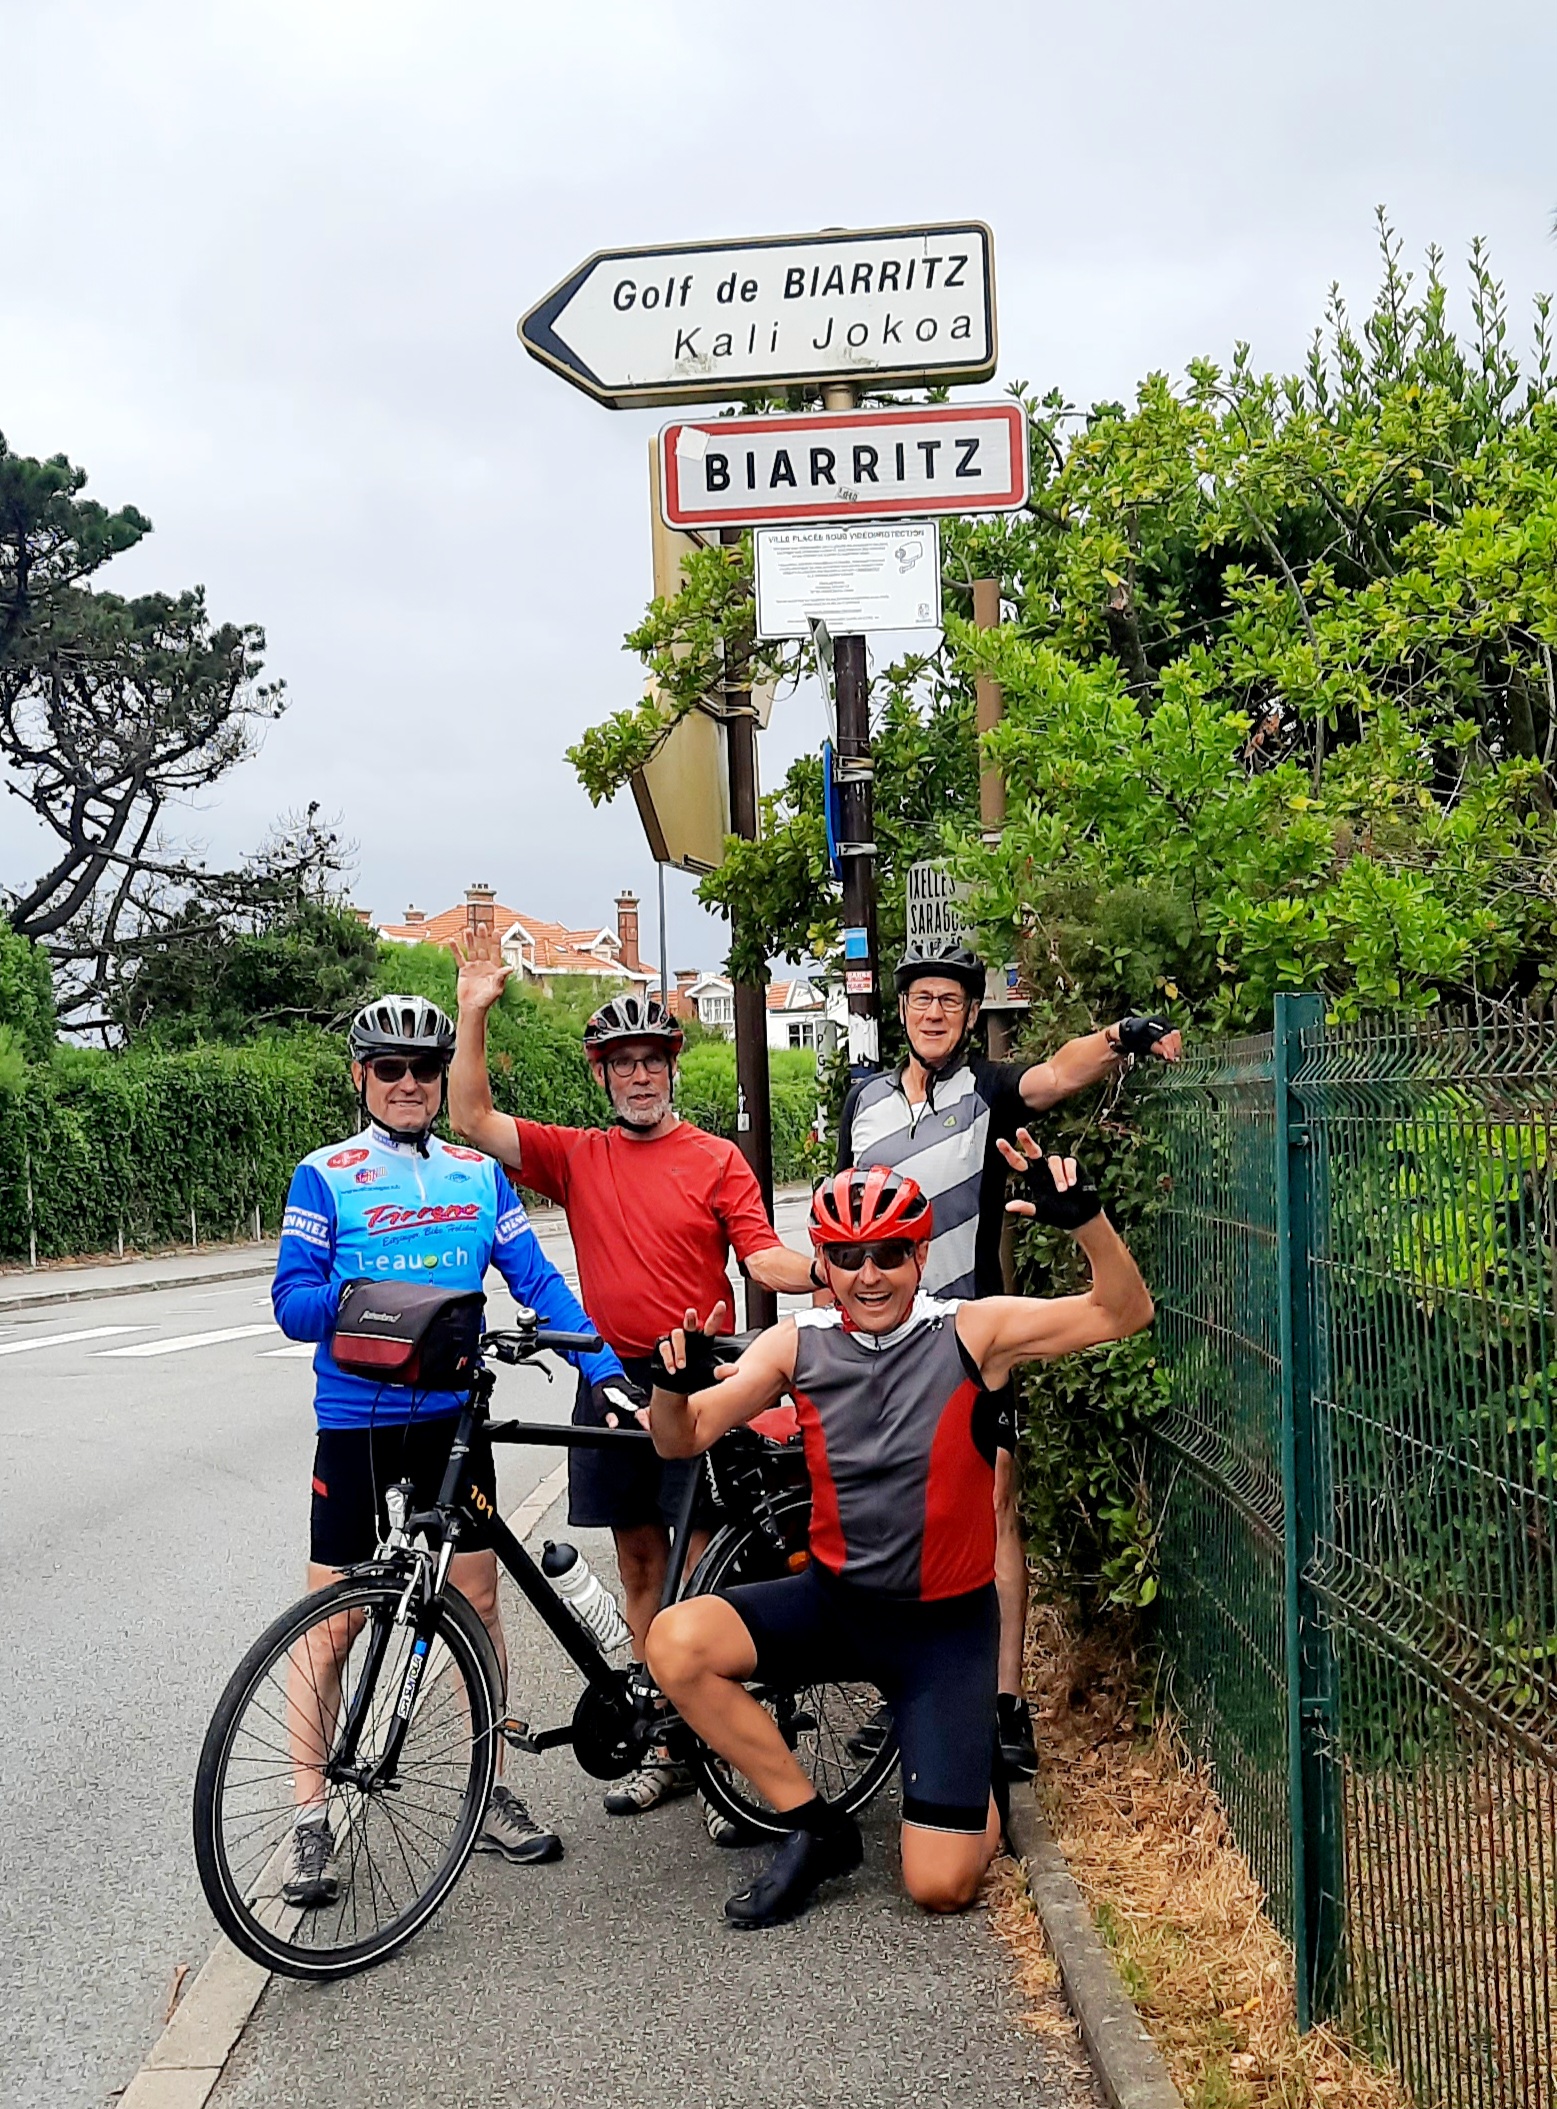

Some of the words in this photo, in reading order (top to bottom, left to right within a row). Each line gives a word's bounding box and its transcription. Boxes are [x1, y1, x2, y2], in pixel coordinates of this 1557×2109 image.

[613, 275, 694, 311] Golf
[716, 272, 759, 304] de
[783, 255, 969, 300] BIARRITZ
[674, 321, 780, 360] Kali
[812, 313, 972, 351] Jokoa
[706, 438, 982, 492] BIARRITZ
[363, 1203, 480, 1228] Tirreno
[471, 1484, 494, 1520] 101
